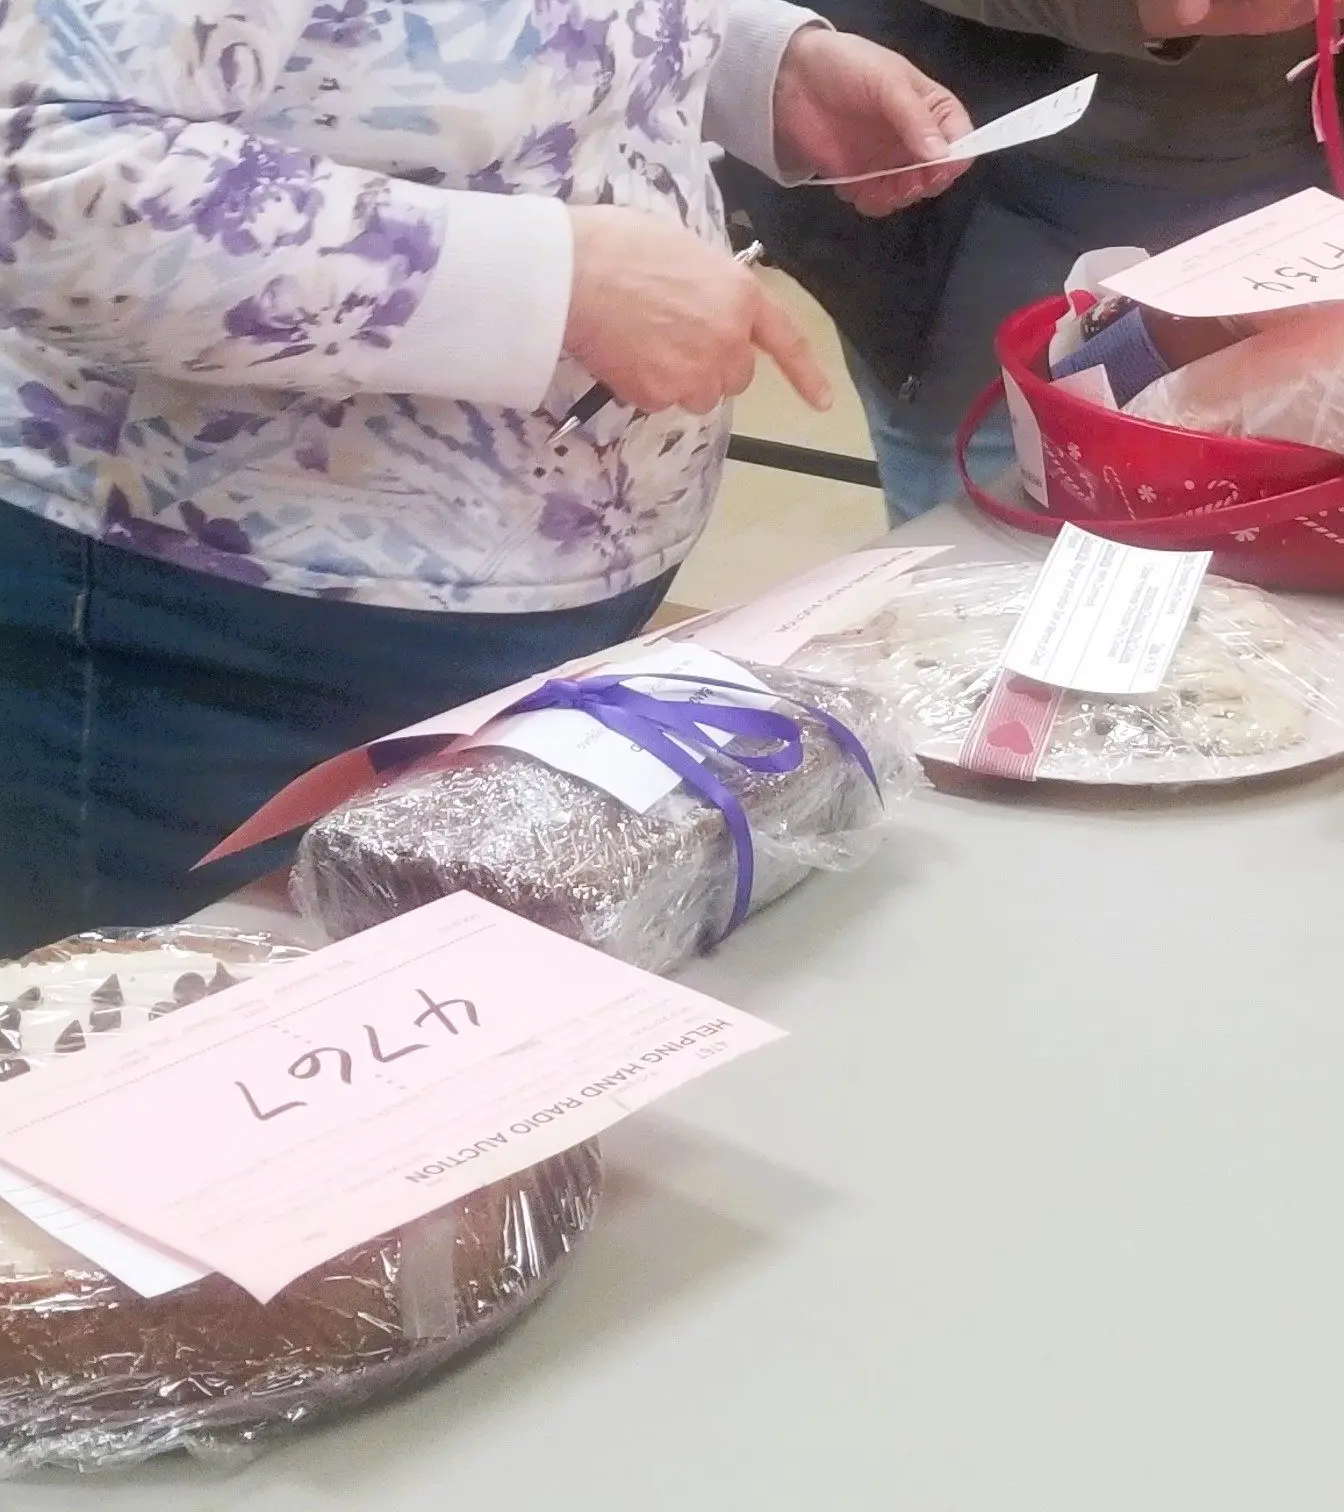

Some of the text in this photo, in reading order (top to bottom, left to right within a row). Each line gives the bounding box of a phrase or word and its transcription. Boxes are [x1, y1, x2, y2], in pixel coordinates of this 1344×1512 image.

[233, 987, 482, 1124] 4767
[404, 1017, 734, 1184] HELPING HAND RADIO AUCTION
